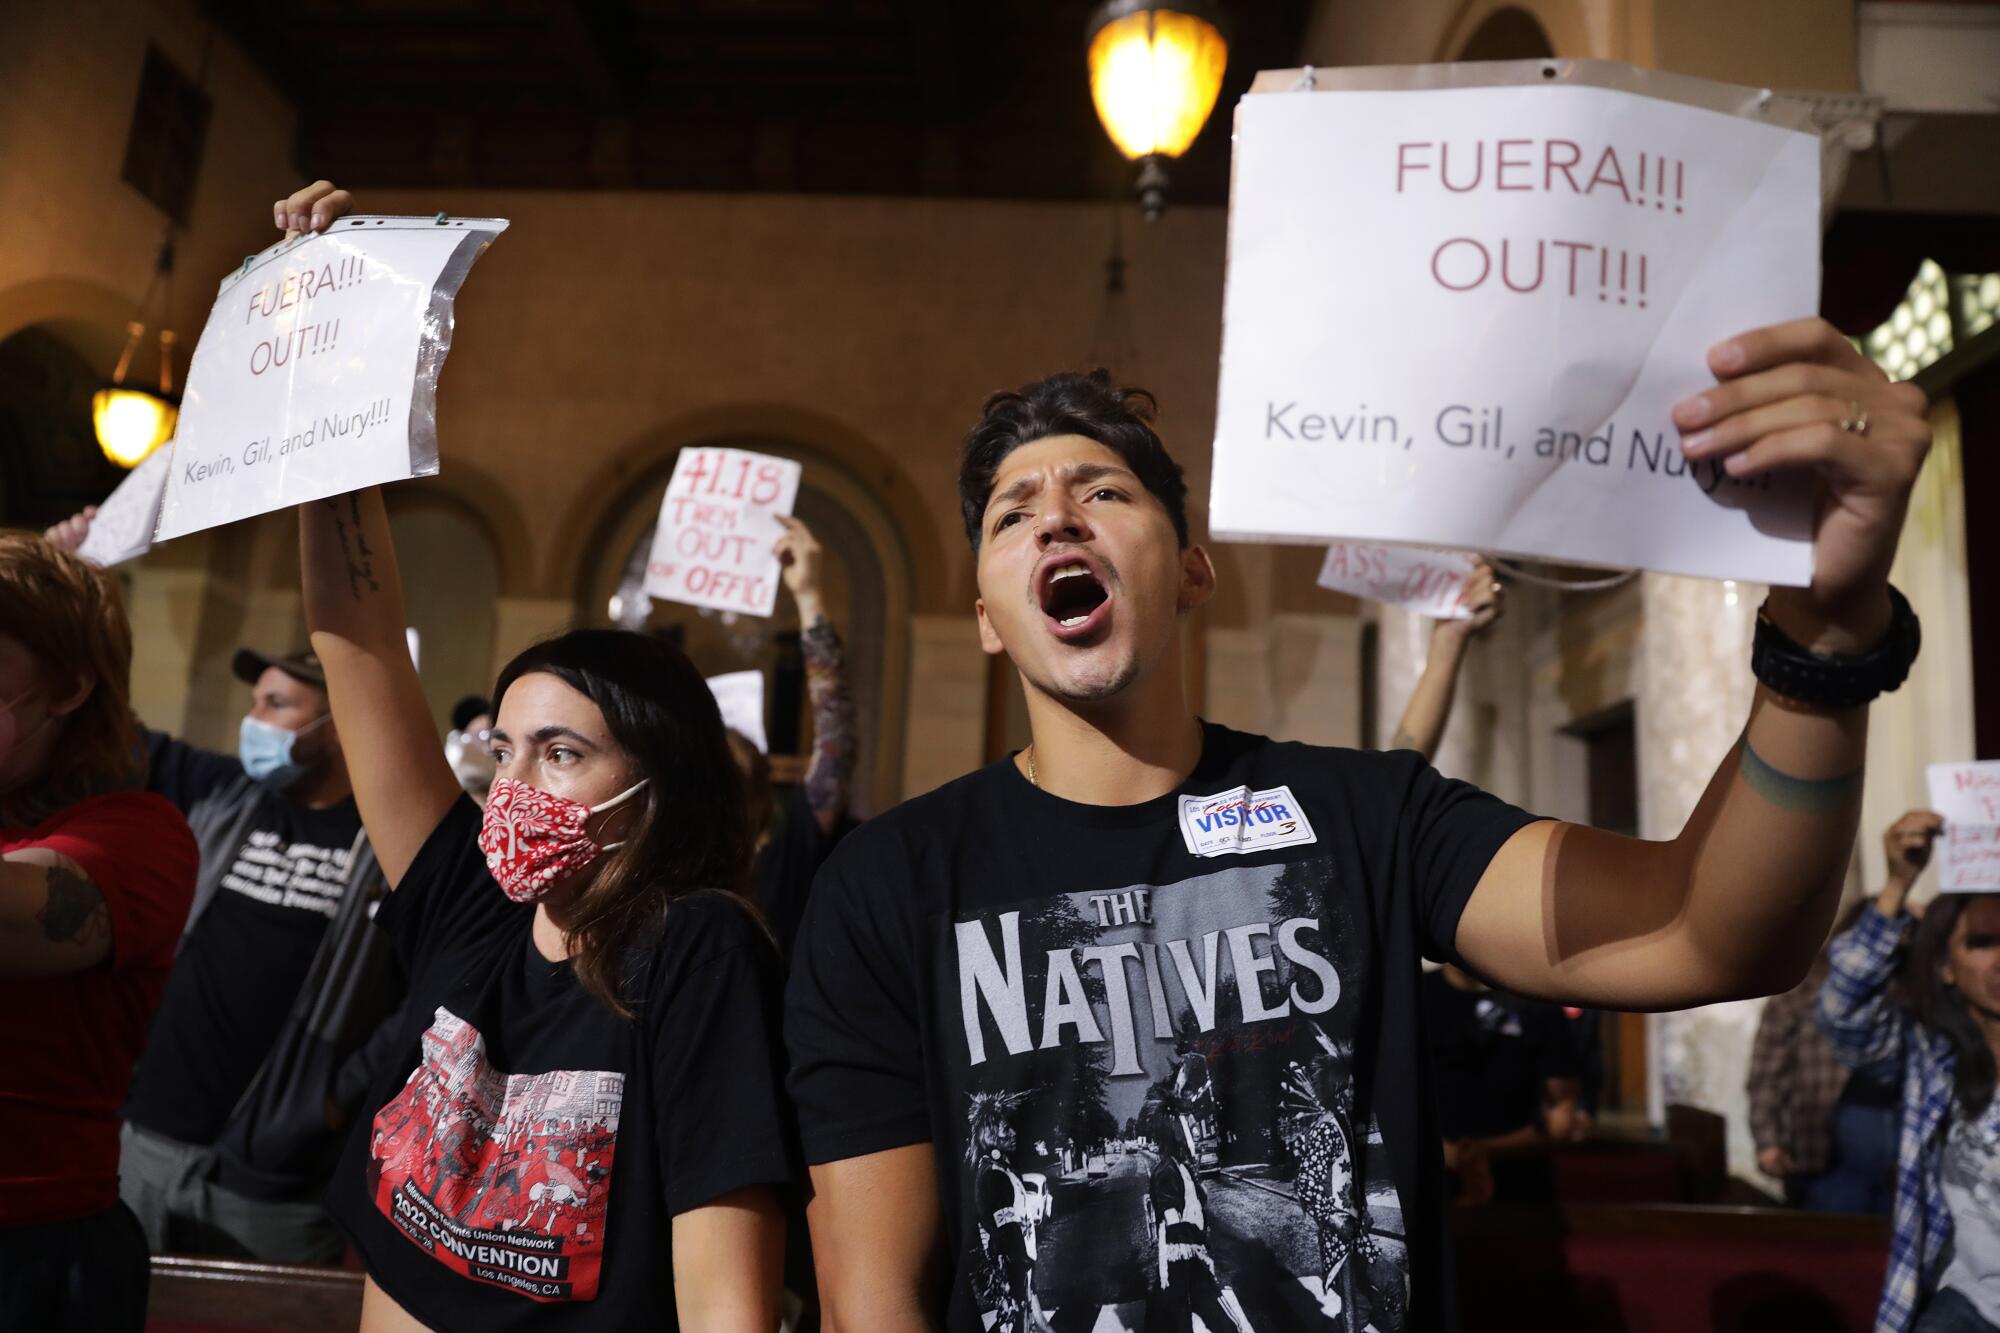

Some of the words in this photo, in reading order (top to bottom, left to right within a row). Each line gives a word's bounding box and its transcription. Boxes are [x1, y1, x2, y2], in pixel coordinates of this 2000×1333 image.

[1396, 138, 1684, 215] FUERA!!!
[246, 252, 367, 325] FUERA!!!
[1431, 235, 1647, 309] OUT!!!
[250, 318, 340, 376] OUT!!!
[183, 453, 236, 485] Kevin,
[243, 436, 273, 466] Gil,
[280, 420, 317, 456] and
[321, 398, 391, 442] Nury!!!
[1266, 401, 1414, 451] Kevin,
[1436, 404, 1516, 460] Gil,
[1535, 423, 1614, 467] and
[677, 525, 758, 566] OUT
[1196, 804, 1293, 834] VISITOR
[1279, 821, 1297, 836] 3
[1089, 889, 1154, 928] THE
[395, 1192, 428, 1231] 2022
[429, 1221, 560, 1278] CONVENTION
[473, 1230, 506, 1243] Union
[507, 1234, 556, 1250] Network
[477, 1267, 495, 1280] Los
[496, 1272, 540, 1294] Angeles,
[542, 1283, 560, 1295] CA
